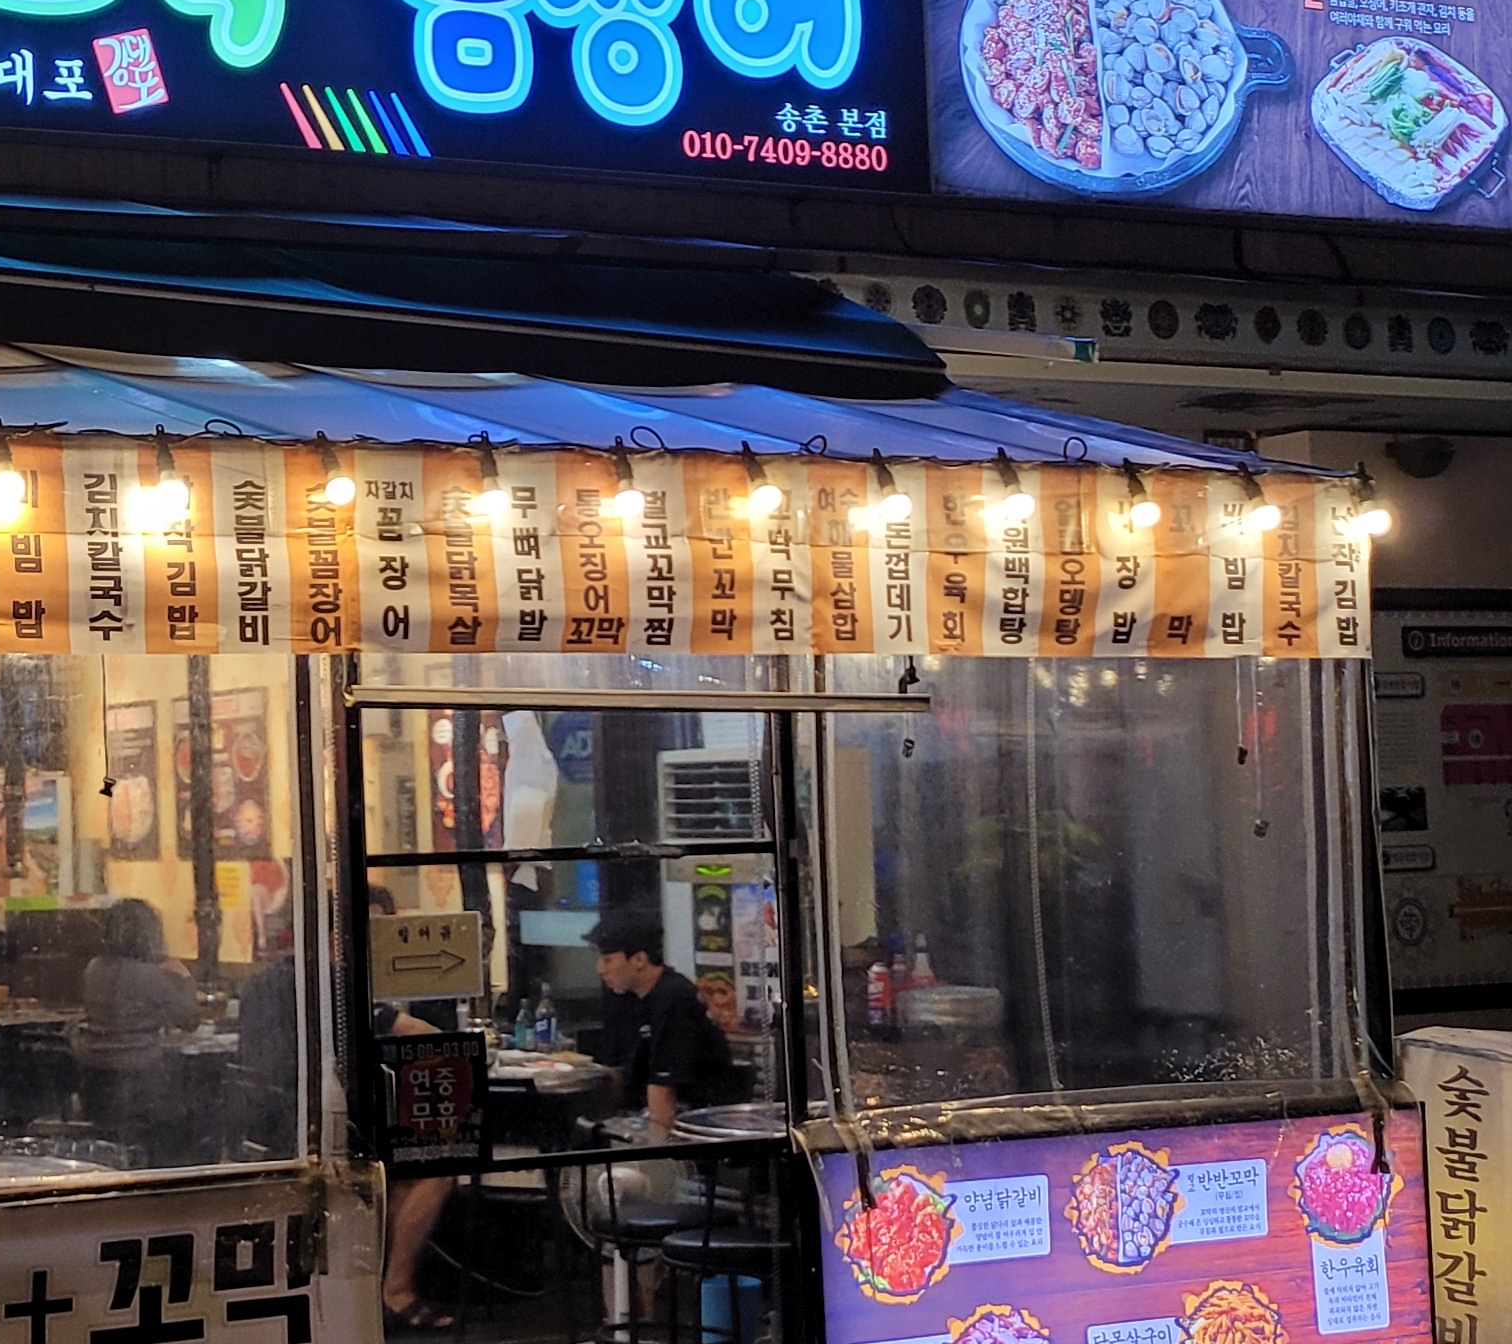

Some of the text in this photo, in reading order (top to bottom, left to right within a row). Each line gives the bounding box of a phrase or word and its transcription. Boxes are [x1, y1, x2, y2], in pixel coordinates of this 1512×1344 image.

[775, 103, 887, 138] 송촌 본점
[683, 130, 888, 171] 010-7409-8880
[364, 480, 414, 501] 자갈치
[84, 473, 123, 642] 김치칼국수
[233, 479, 271, 646] 숯불닭갈비
[376, 507, 410, 640] 꼼장어
[442, 485, 482, 646] 숯불닭목살
[511, 486, 548, 641] 무뼈닭발
[642, 491, 676, 646] 벌교꼬막찜
[567, 617, 625, 645] 꼬막
[561, 730, 592, 758] AD
[409, 1067, 457, 1096] 연중
[411, 1101, 458, 1130] 무휴
[1198, 1166, 1259, 1191] 반반꼬막
[964, 1185, 1042, 1212] 양념닭갈비
[1320, 1254, 1379, 1280] 한우육회
